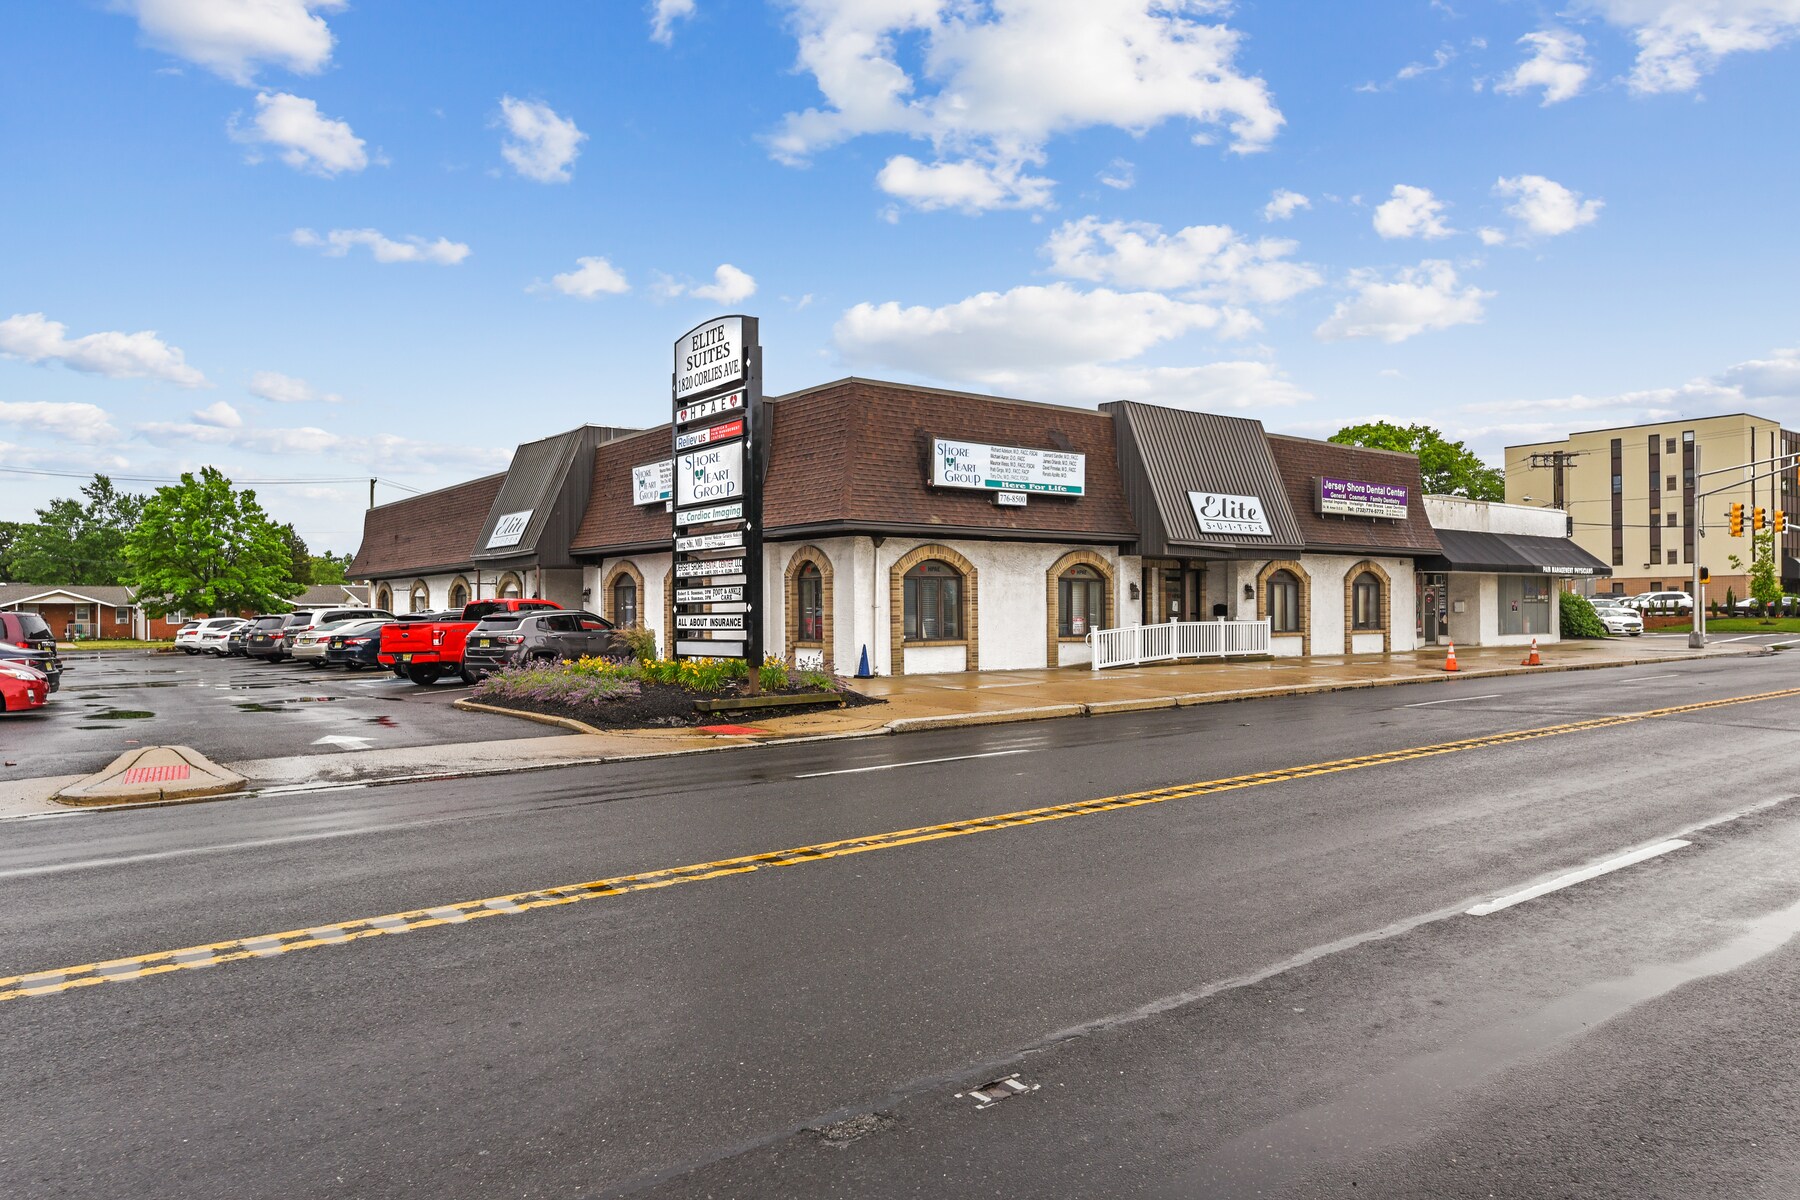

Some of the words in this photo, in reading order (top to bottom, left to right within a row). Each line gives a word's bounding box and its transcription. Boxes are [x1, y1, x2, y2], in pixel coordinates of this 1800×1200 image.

[692, 324, 725, 352] ELITE
[686, 342, 730, 371] SUITES
[678, 375, 693, 392] 1820
[694, 364, 722, 387] CORLIES
[724, 359, 740, 377] AVE.
[937, 443, 969, 457] SHORE
[685, 452, 720, 471] SHORE
[944, 456, 976, 472] HEART
[693, 466, 730, 486] HEART
[945, 470, 980, 486] GROUP
[693, 481, 735, 500] GROUP
[1324, 480, 1345, 492] Jersey
[1347, 483, 1365, 493] Shore
[1367, 485, 1385, 495] Dental
[1386, 487, 1405, 497] Center
[1000, 495, 1025, 503] 776-8500
[1200, 496, 1260, 520] Elite
[687, 510, 710, 522] Cardiac
[712, 506, 741, 519] Imaging
[690, 618, 708, 626] ABOUT
[710, 618, 741, 626] INSURANCE
